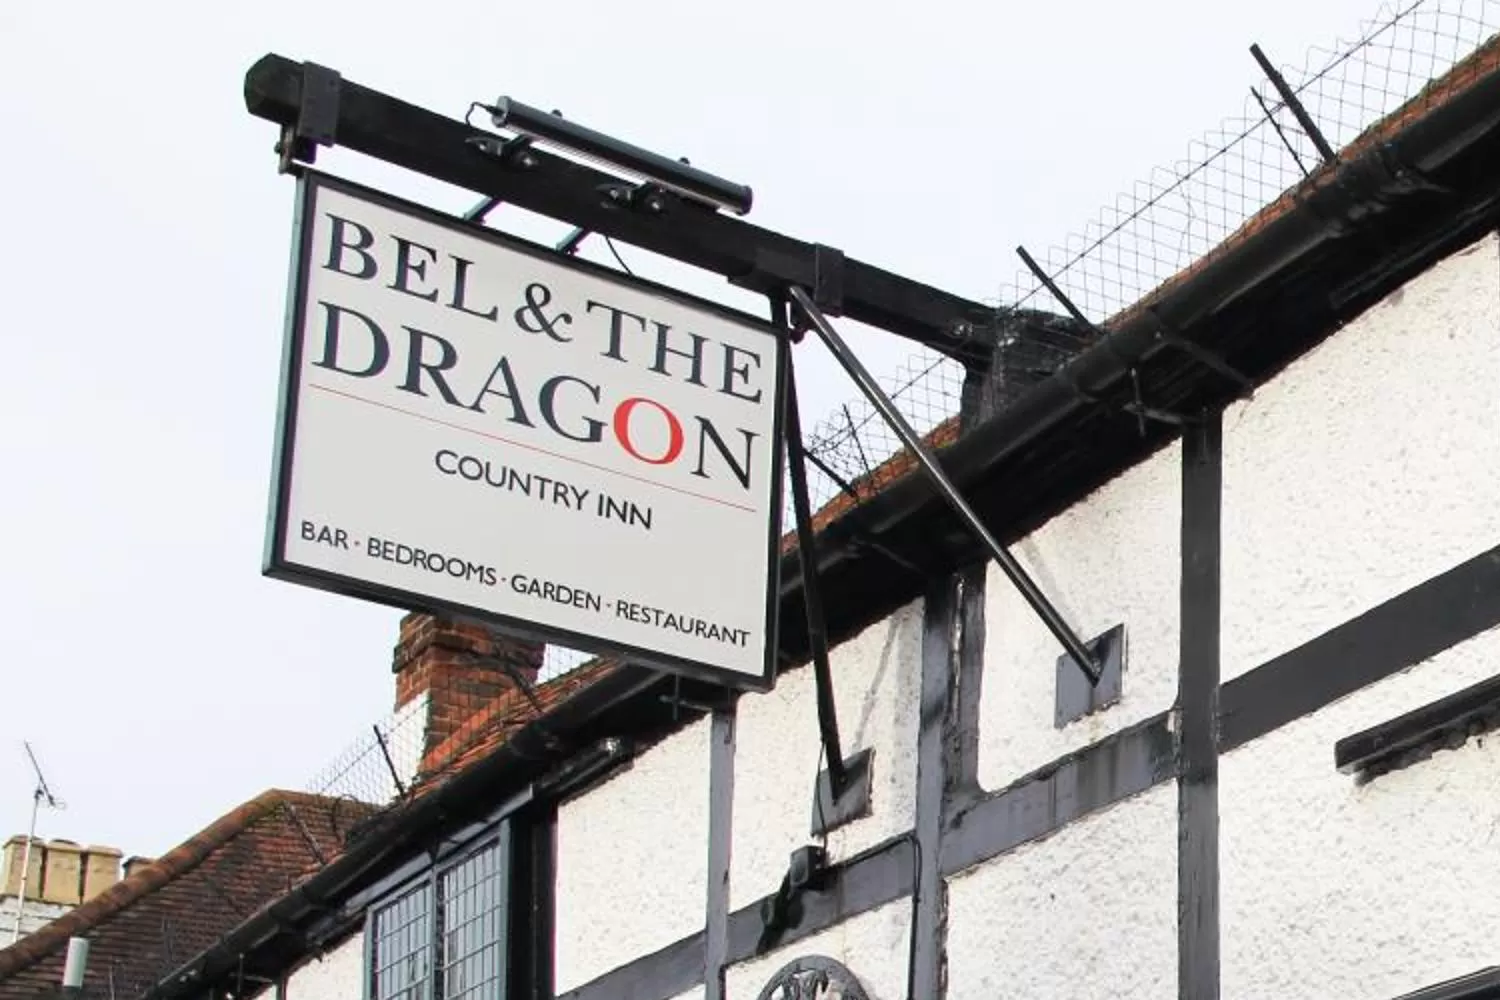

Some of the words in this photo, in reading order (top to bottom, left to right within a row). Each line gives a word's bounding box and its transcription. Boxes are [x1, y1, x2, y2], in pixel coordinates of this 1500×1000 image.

[321, 213, 498, 322] BEL
[514, 282, 573, 342] &
[586, 298, 763, 404] THE
[311, 301, 760, 491] DRAGON
[435, 448, 589, 510] COUNTRY
[597, 493, 652, 530] INN
[300, 521, 350, 549] BAR
[366, 537, 497, 586] BEDROOMS
[510, 574, 602, 613] GARDEN
[615, 600, 751, 648] RESTAURANT
